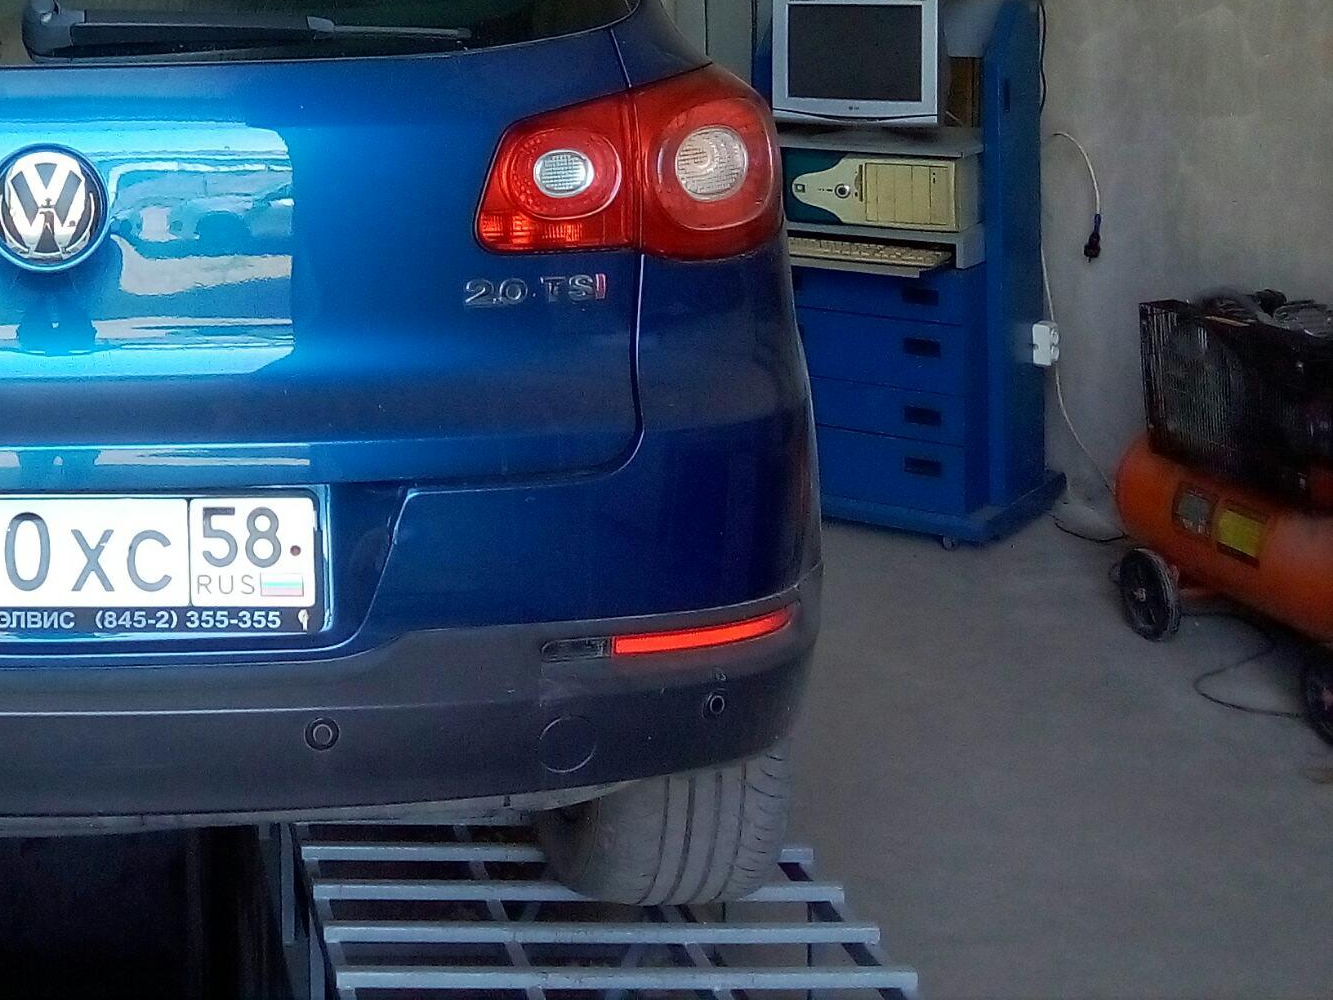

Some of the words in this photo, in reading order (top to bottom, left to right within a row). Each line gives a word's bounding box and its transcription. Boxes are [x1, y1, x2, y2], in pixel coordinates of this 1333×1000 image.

[540, 273, 607, 304] TSI
[202, 506, 281, 568] 58
[197, 574, 257, 595] RUS
[95, 609, 178, 629] (845-2)
[185, 610, 282, 629] 355-355
